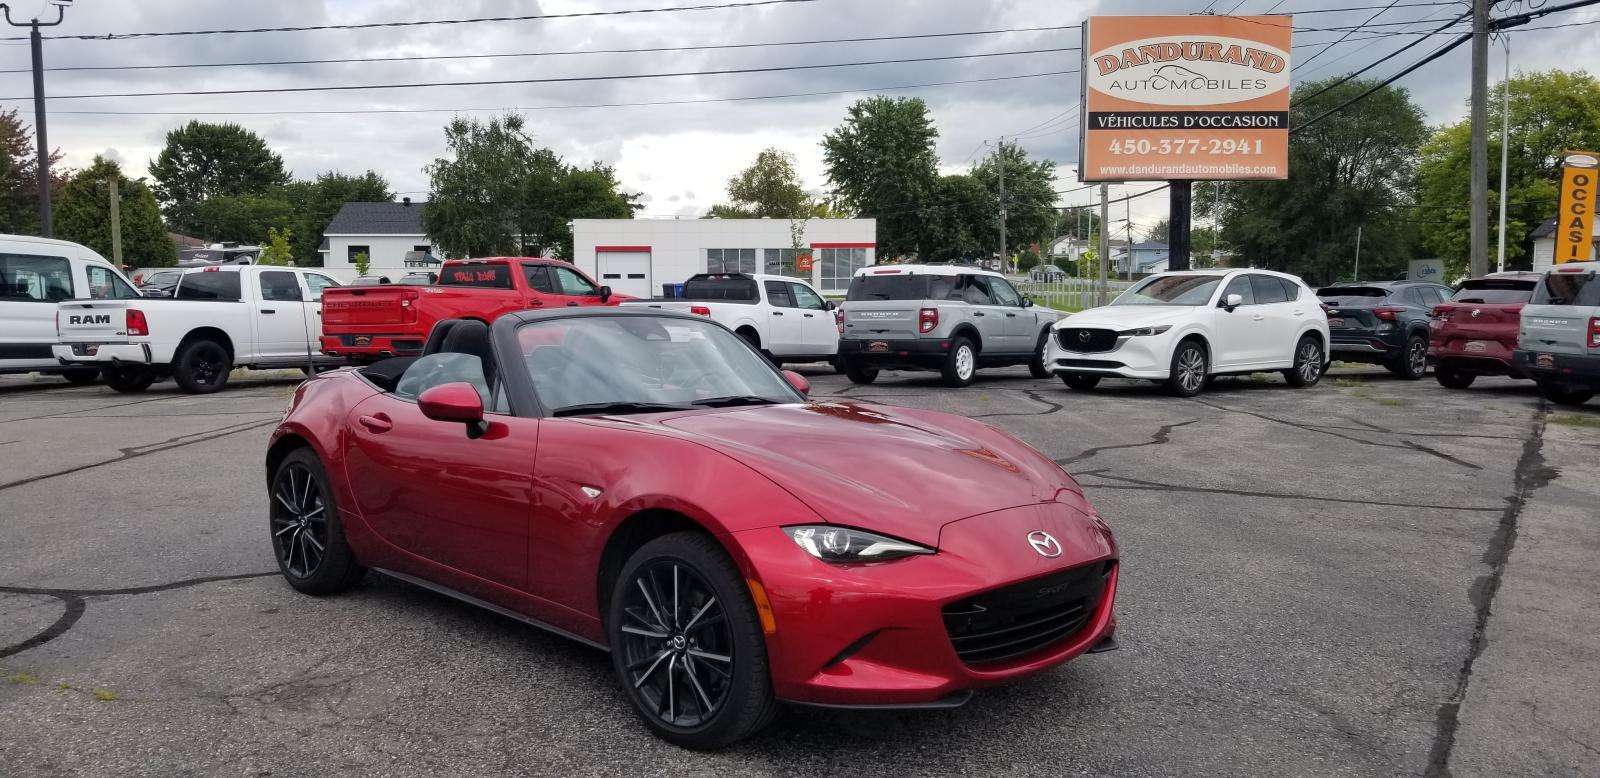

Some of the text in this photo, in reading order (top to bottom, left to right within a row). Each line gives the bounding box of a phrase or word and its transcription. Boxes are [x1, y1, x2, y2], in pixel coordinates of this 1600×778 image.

[1094, 41, 1286, 76] DANDURAND
[1109, 77, 1267, 91] AUTOMOBILES
[1098, 113, 1279, 128] VÉHICULES D'OCCASION
[1108, 137, 1264, 155] 450-377-2941
[1099, 163, 1277, 175] www.dandurandautomobiles.com
[1568, 174, 1590, 263] OCCASI
[69, 314, 111, 325] RAM
